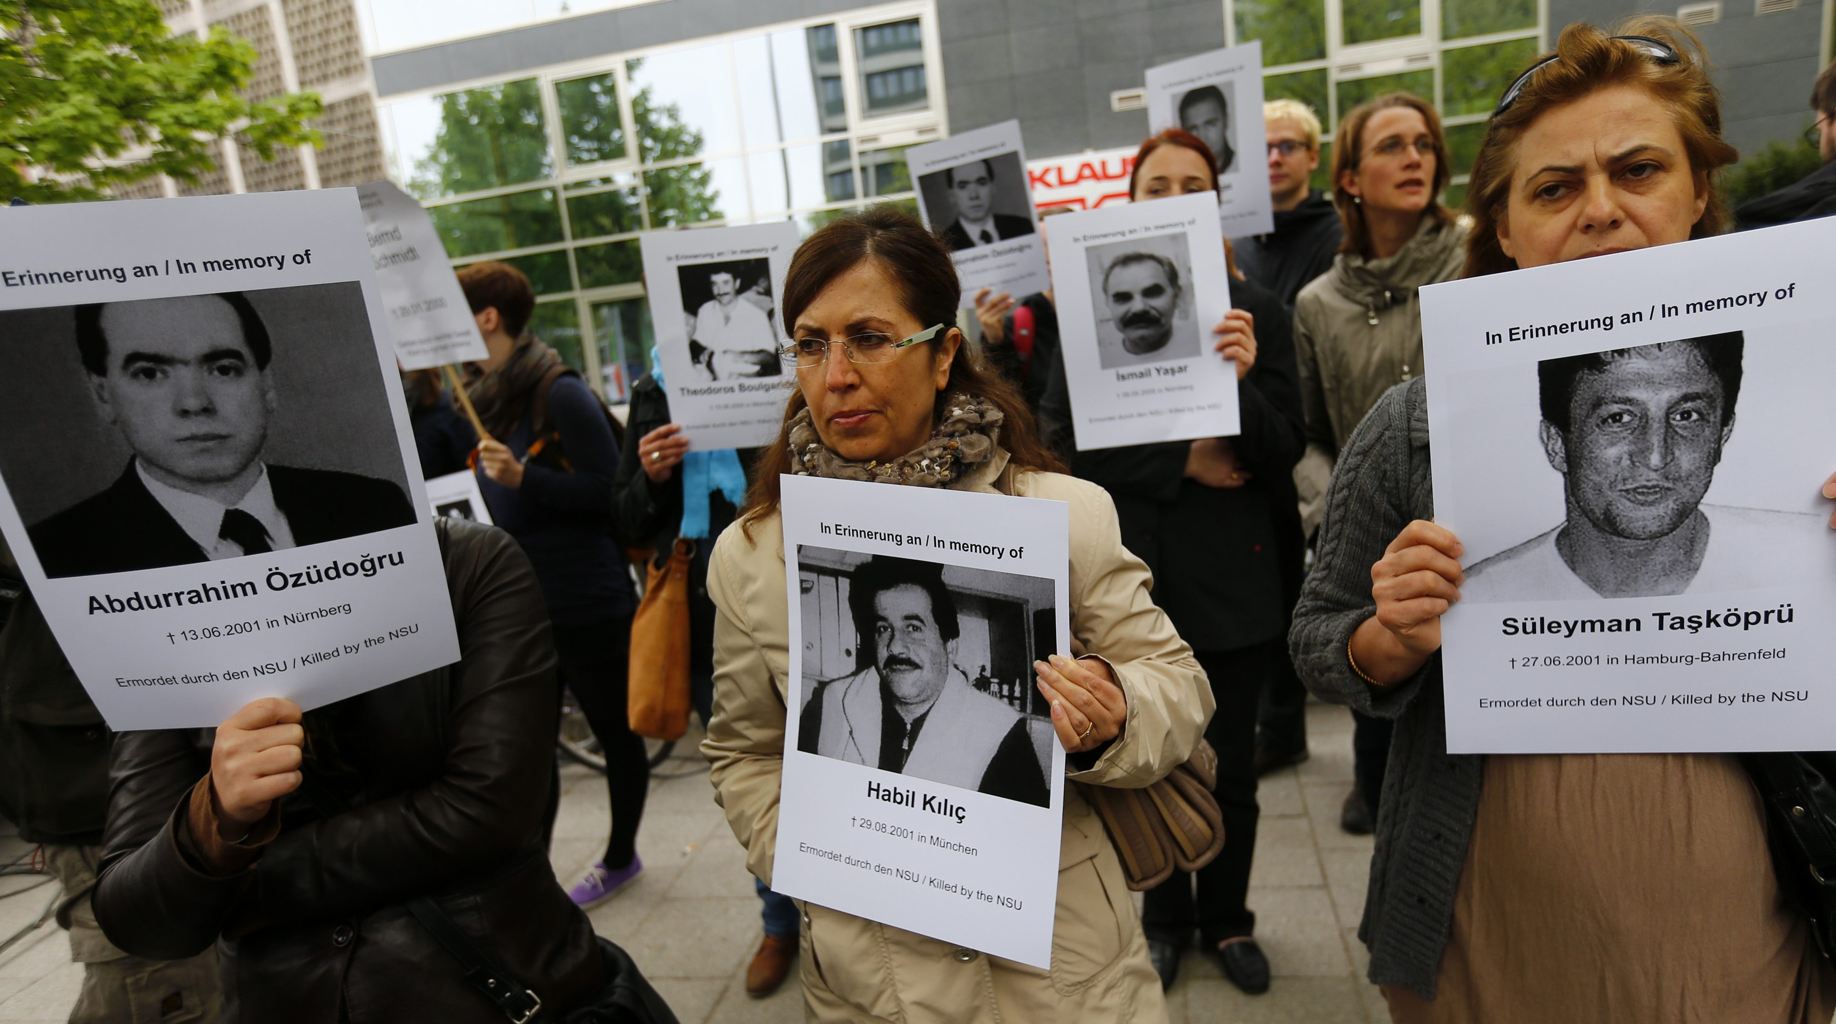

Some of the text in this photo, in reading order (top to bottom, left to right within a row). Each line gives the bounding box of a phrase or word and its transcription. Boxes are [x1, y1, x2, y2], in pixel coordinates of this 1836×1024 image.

[1, 264, 127, 288] Erinnerung
[132, 260, 159, 278] an
[175, 258, 197, 275] In
[203, 253, 286, 273] memory
[292, 249, 312, 265] of
[1485, 331, 1502, 346] In
[1508, 313, 1614, 343] Erinnerung
[1620, 309, 1643, 325] an
[1661, 303, 1679, 318] In
[1685, 291, 1768, 315] memory
[1774, 283, 1796, 300] of
[1153, 364, 1188, 377] Yaşar
[680, 386, 736, 397] Theodoros
[820, 522, 831, 534] In
[835, 524, 903, 546] Erinnerung
[906, 535, 922, 547] an
[933, 536, 945, 549] In
[949, 541, 1005, 559] memory
[1009, 546, 1024, 559] of
[88, 551, 405, 615] Abdurrahim Özüdoğru
[181, 619, 261, 642] 13.06.2001
[266, 616, 279, 629] in
[283, 601, 352, 625] Nürnberg
[1502, 603, 1795, 638] Süleyman Taşköprü
[116, 673, 179, 688] Ermordet
[181, 671, 219, 685] durch
[223, 668, 250, 682] den
[253, 660, 288, 678] NSU
[301, 647, 341, 667] Killed
[344, 641, 360, 655] by
[364, 634, 385, 648] the
[389, 623, 420, 641] NSU
[1521, 655, 1601, 668] 27.06.2001
[1606, 654, 1619, 665] in
[1624, 648, 1787, 667] Hamburg-Bahrenfeld
[1479, 697, 1542, 709] Ermordet
[1546, 696, 1586, 708] durch
[1590, 696, 1617, 707] den
[1622, 695, 1656, 706] NSU
[1671, 693, 1713, 705] Killed
[1718, 692, 1736, 706] by
[1741, 691, 1766, 704] the
[1771, 690, 1809, 702] NSU
[867, 781, 967, 823] Habil Kılıç
[860, 818, 915, 841] 29.08.2001
[917, 832, 927, 844] in
[929, 835, 978, 856] München
[800, 842, 842, 863] Ermordet
[844, 855, 871, 871] durch
[874, 862, 893, 876] den
[896, 868, 920, 883] NSU
[928, 876, 958, 894] Killed
[960, 884, 973, 899] by
[976, 890, 994, 903] the
[997, 895, 1023, 911] NSU
